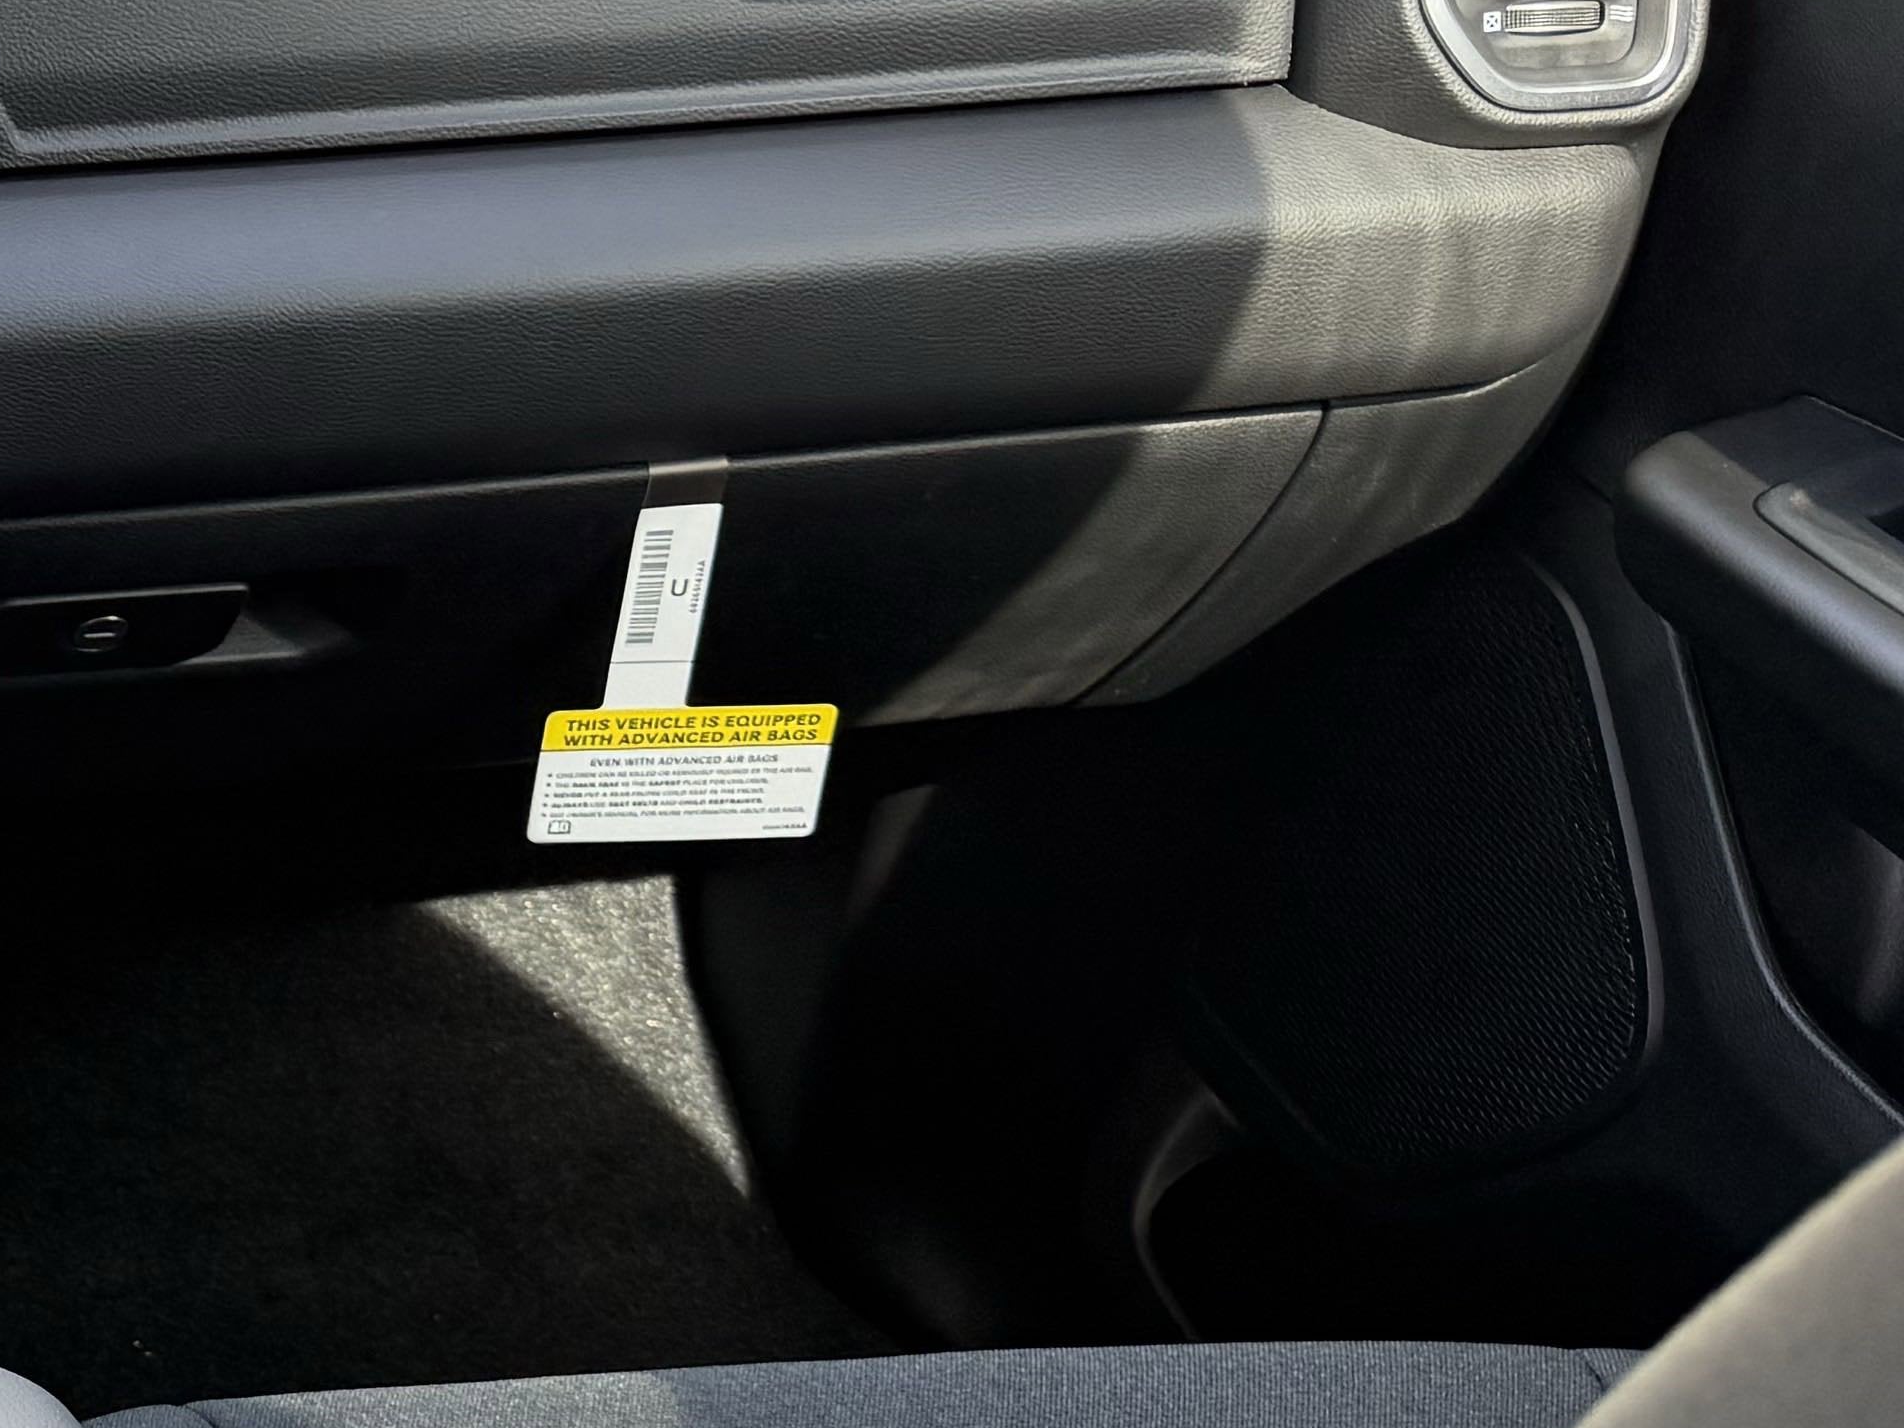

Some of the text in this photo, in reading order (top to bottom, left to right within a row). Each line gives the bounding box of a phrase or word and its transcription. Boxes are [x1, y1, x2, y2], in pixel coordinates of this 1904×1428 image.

[567, 713, 822, 732] THIS VEHICLE IS EQUIPPED
[564, 729, 818, 747] WITH ADVANCED AIR BAGS
[590, 757, 622, 767] EVEN
[658, 754, 723, 766] ADVANCED
[724, 754, 746, 764] AIR
